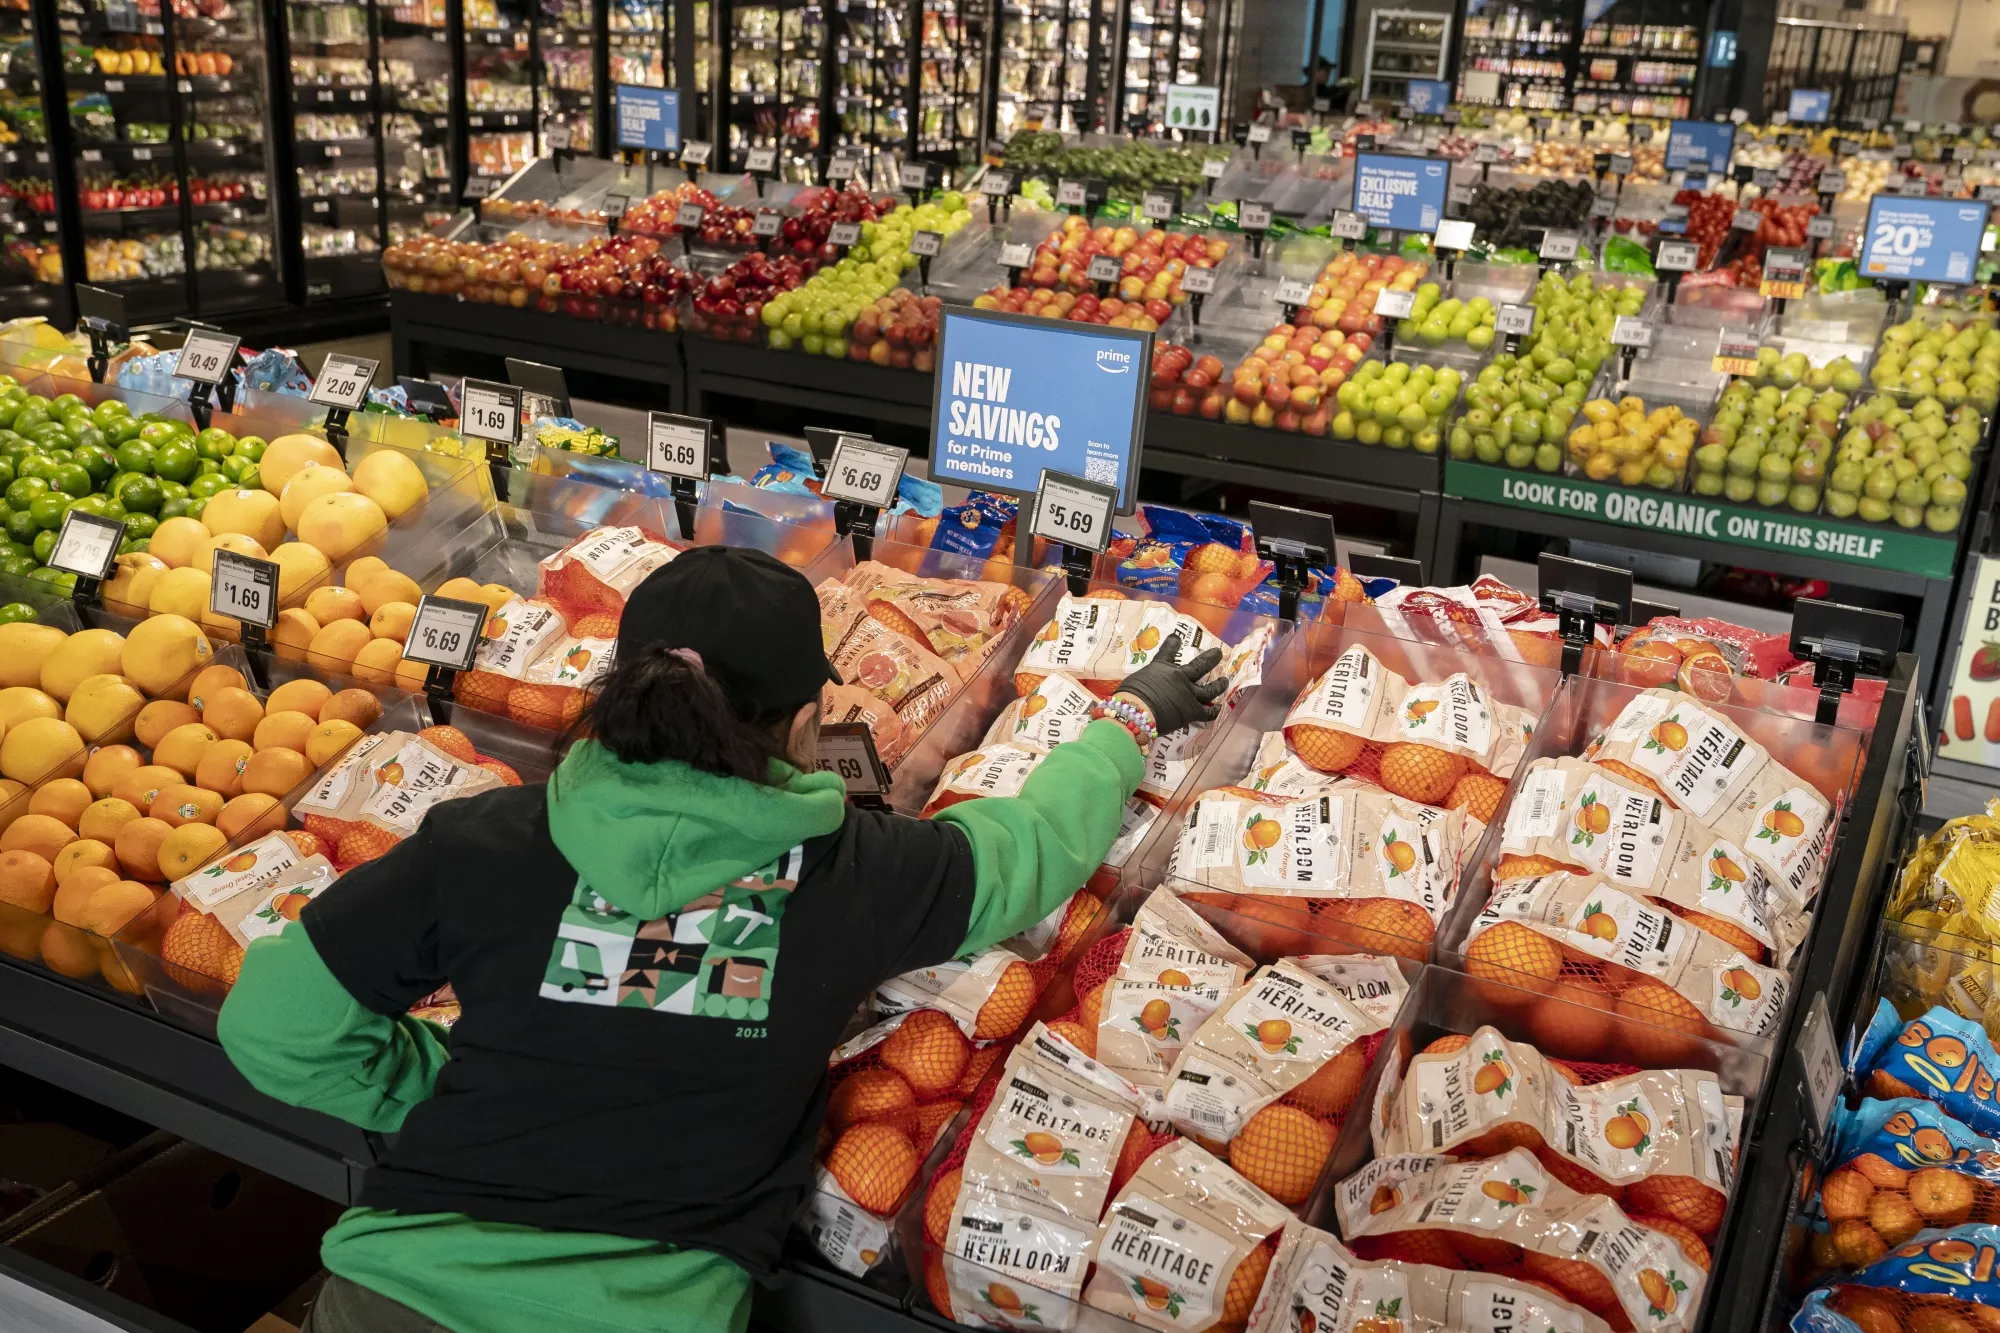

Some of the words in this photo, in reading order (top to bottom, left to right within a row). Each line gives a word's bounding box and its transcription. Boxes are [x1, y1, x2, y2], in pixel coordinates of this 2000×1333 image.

[1360, 175, 1418, 196] EXCLUSIVE
[1358, 192, 1393, 210] DEALS
[1769, 281, 1795, 297] SALE
[189, 353, 218, 372] $0.49
[1096, 349, 1130, 364] prime
[1720, 358, 1750, 374] SALE
[326, 376, 356, 396] $2.09
[952, 361, 1011, 403] NEW
[471, 407, 505, 430] $1.69
[949, 400, 1060, 451] SAVINGS
[660, 442, 694, 465] $6.69
[947, 440, 967, 456] for
[970, 443, 1012, 463] Prime
[1086, 448, 1102, 457] learn
[1103, 451, 1119, 460] more
[1087, 440, 1102, 449] Scan
[842, 466, 881, 492] $6.69
[946, 458, 1013, 480] members
[1050, 503, 1093, 534] $5.69
[1503, 478, 1554, 506] LOOK
[1559, 486, 1597, 513] FOR
[1605, 492, 1721, 538] ORGANIC
[1727, 515, 1763, 540] ON
[1763, 522, 1812, 548] THIS
[1814, 529, 1884, 559] SHELF
[224, 582, 260, 610] $1.69
[423, 626, 461, 653] $6.69
[1326, 653, 1354, 718] HÉRITAGE
[1450, 680, 1468, 743] HEIRLOOM
[1720, 738, 1733, 754] KINGS
[1675, 726, 1725, 797] HÉRITAGE
[1712, 754, 1724, 768] RIVER
[1296, 804, 1313, 882] HEIRLOOM
[1616, 797, 1644, 878] HEIRLOOM
[1795, 834, 1809, 852] Navel
[1779, 850, 1797, 869] Oranges
[234, 870, 256, 885] Navel
[208, 881, 234, 898] Oranges
[1142, 941, 1231, 969] HÉRITAGE
[1258, 985, 1350, 1033] HÉRITAGE
[735, 1026, 767, 1039] 2023
[1445, 1060, 1469, 1134] HÉRITAGE
[1010, 1099, 1111, 1144] HÉRITAGE
[1349, 1157, 1436, 1204] HÉRITAGE
[967, 1234, 987, 1244] KINGS
[963, 1241, 1071, 1275] HEIRLOOM
[1111, 1230, 1213, 1286] HÉRITAGE
[1177, 1283, 1205, 1299] Navel
[1338, 1304, 1351, 1330] Navel
[1348, 1278, 1365, 1304] Oranges
